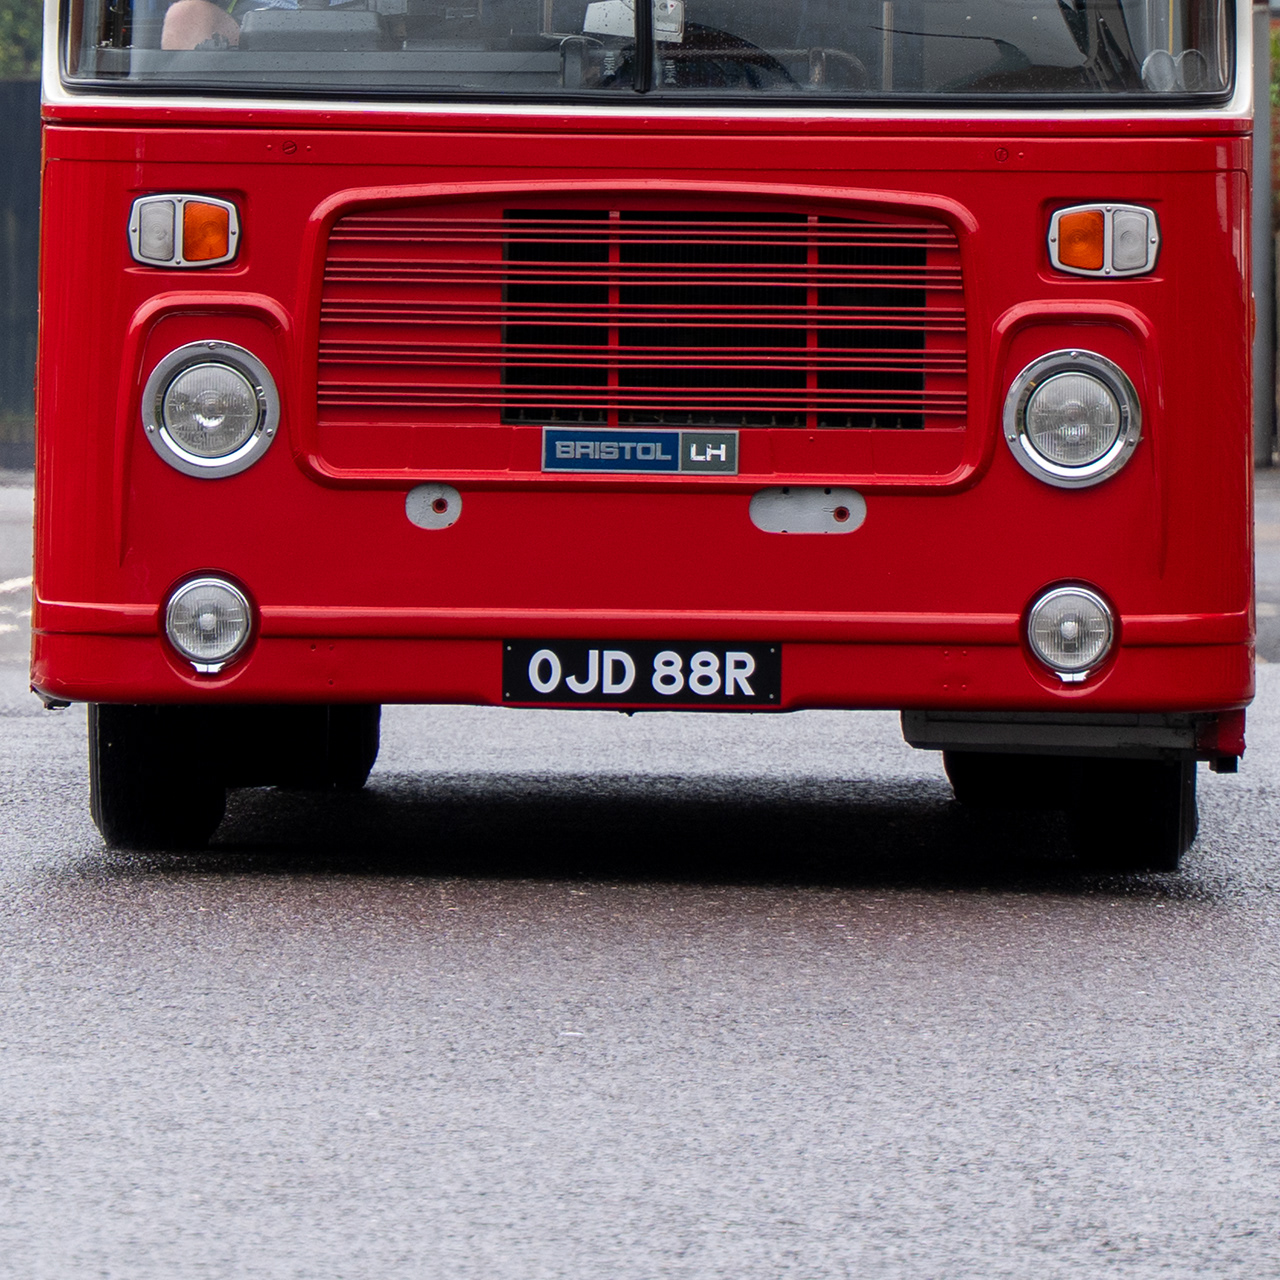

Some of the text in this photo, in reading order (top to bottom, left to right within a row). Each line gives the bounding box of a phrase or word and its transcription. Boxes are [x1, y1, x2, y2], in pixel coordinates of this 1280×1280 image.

[555, 440, 672, 461] BRISTOL
[689, 442, 726, 462] LH
[528, 649, 756, 696] OJD 88R
